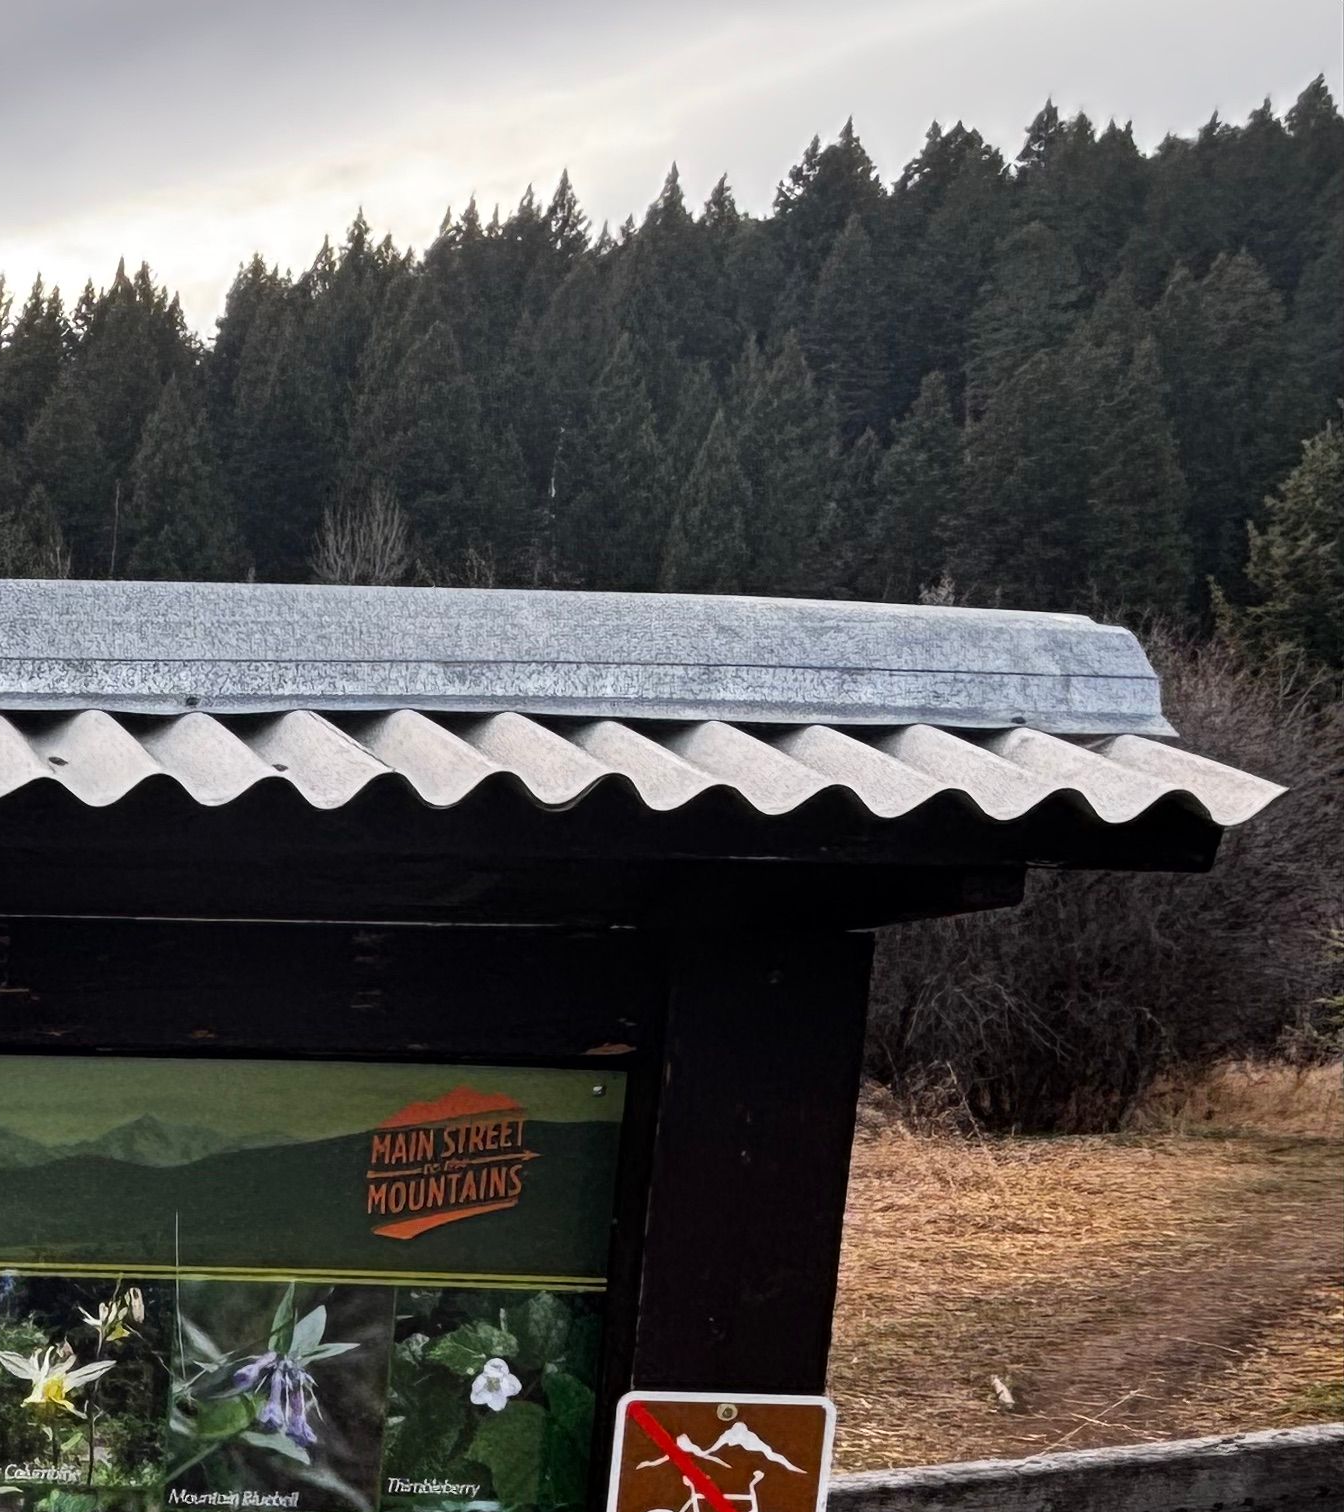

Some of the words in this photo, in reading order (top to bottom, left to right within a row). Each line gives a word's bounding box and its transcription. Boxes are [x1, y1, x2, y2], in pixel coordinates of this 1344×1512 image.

[371, 1129, 434, 1164] MAIN
[442, 1120, 525, 1158] STREET
[367, 1164, 523, 1214] MOUNTAINS
[388, 1477, 480, 1498] Thimbleberry
